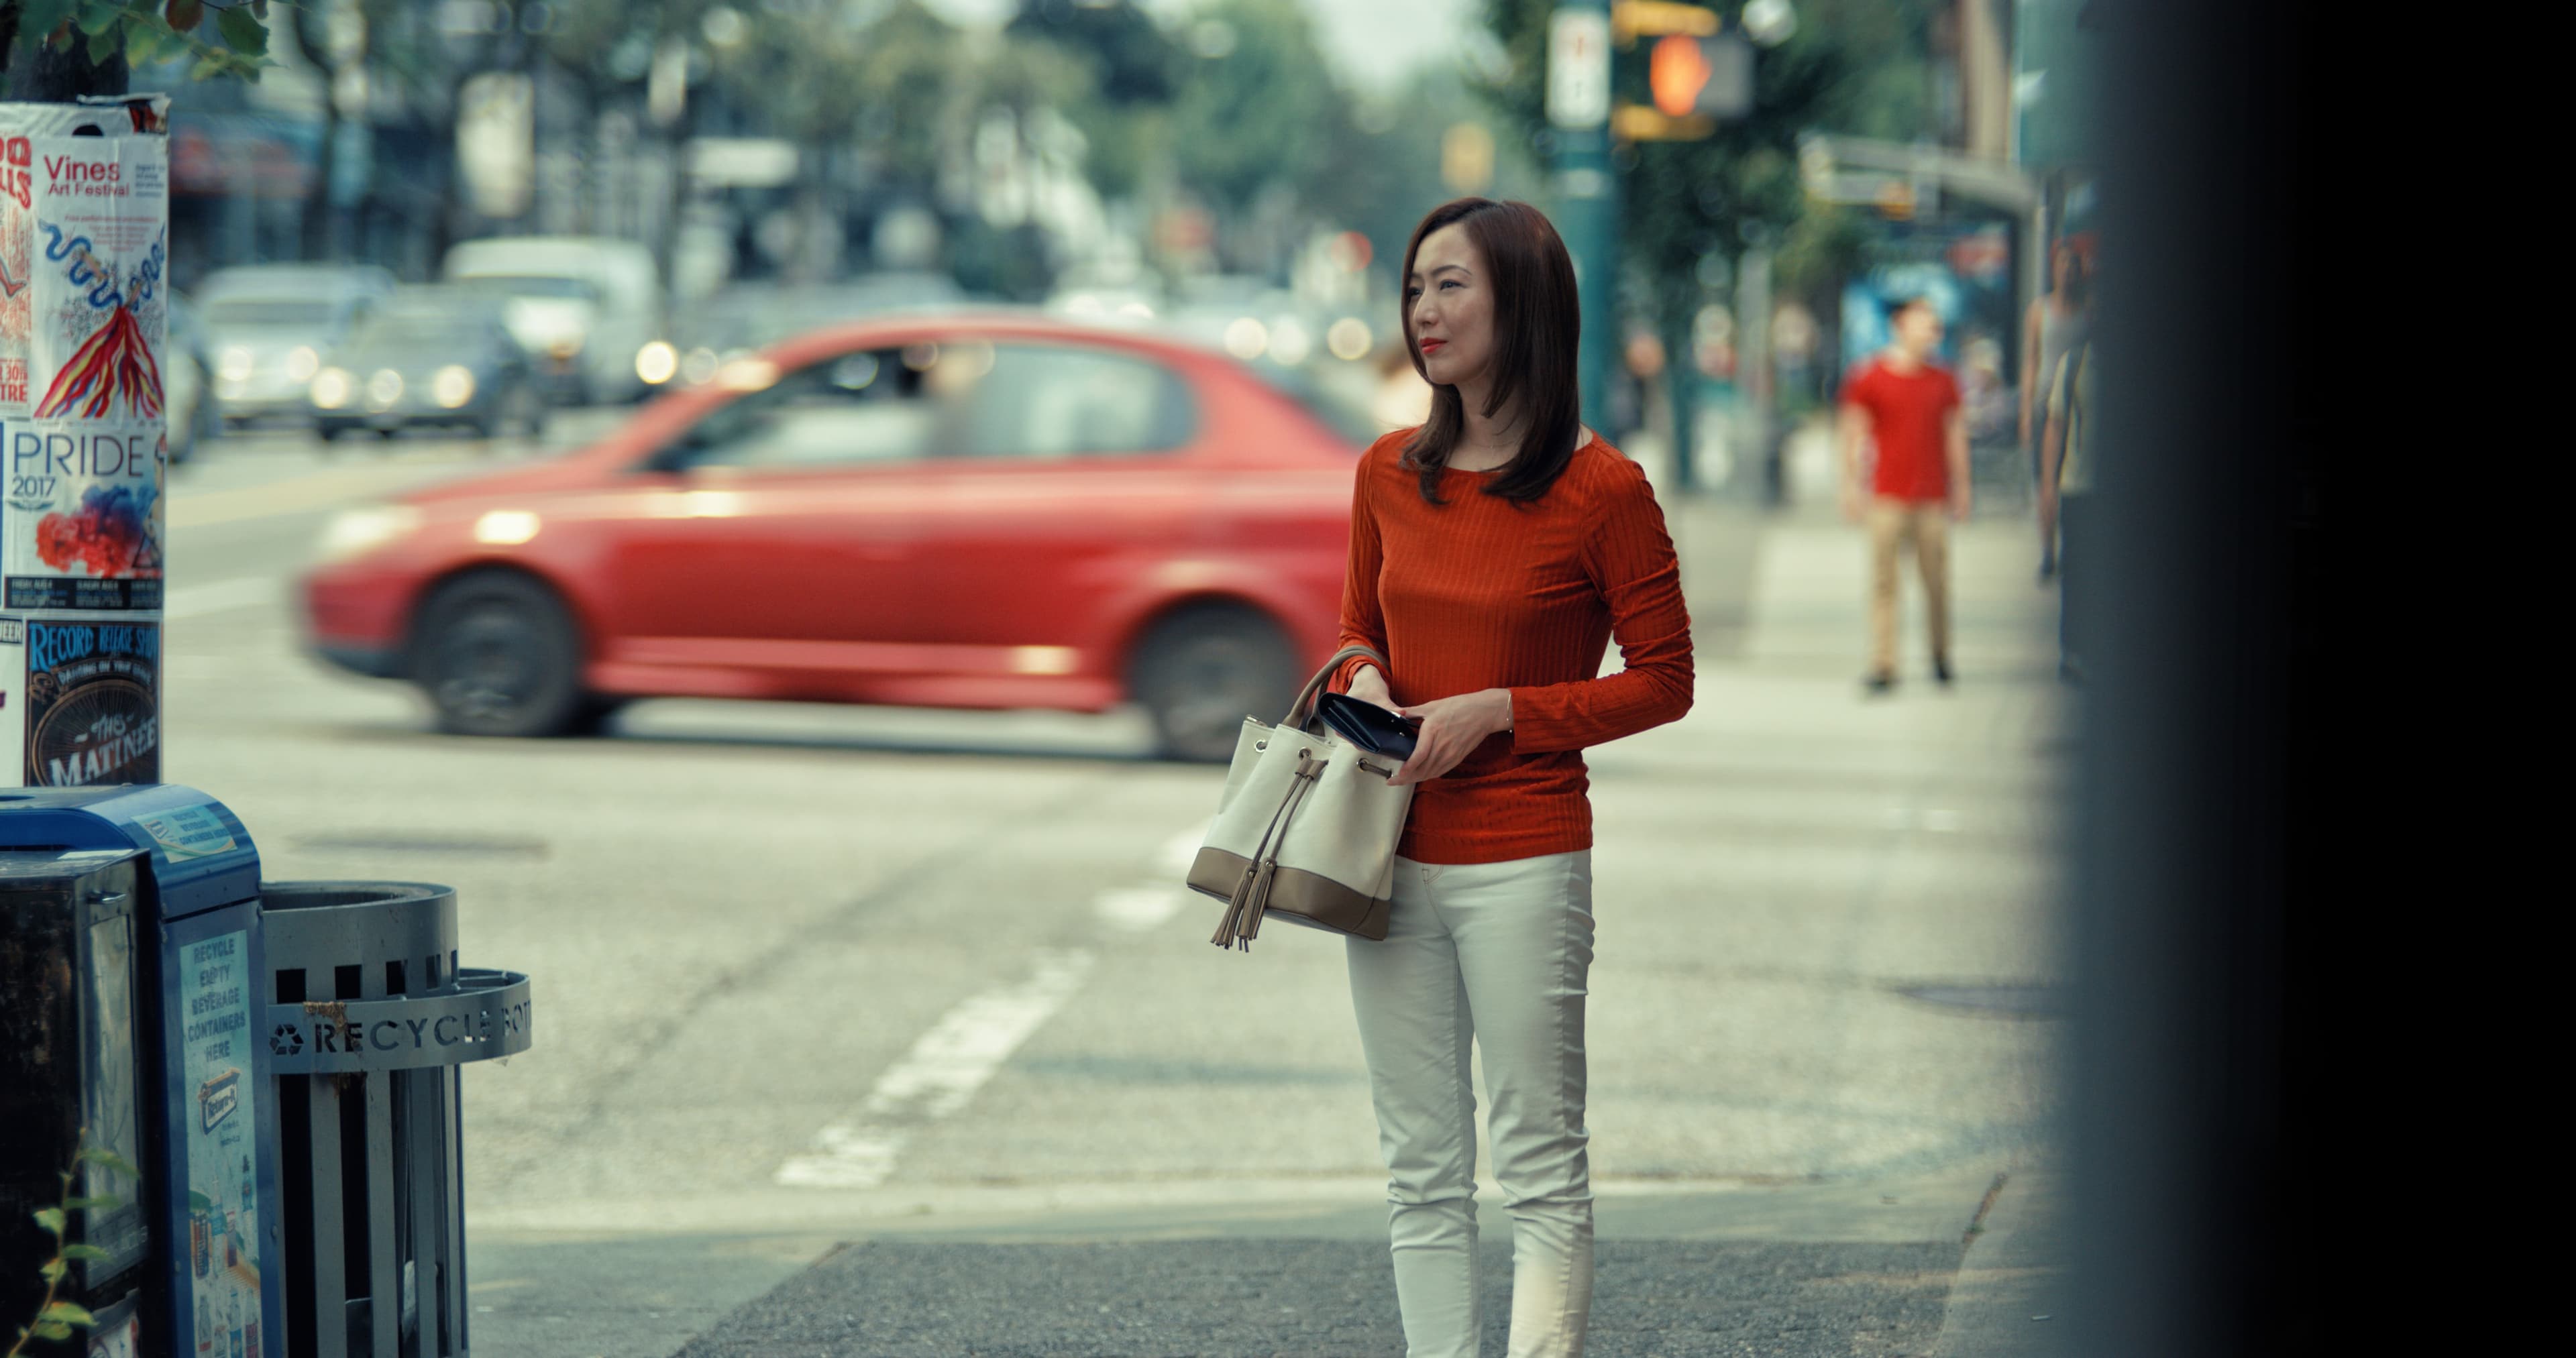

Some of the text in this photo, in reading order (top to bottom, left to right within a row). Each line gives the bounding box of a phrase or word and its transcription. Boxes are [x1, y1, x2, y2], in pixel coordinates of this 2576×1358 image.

[44, 154, 121, 182] Vines
[48, 182, 70, 196] Art
[74, 182, 130, 196] Festival
[14, 431, 144, 477] PRIDE
[12, 475, 56, 498] 2017
[29, 622, 94, 673] RECORD
[50, 716, 156, 787] MATINEE
[193, 938, 235, 964] RECYCLE
[199, 964, 231, 987] EMPTY
[192, 987, 240, 1015] BEVERAGE
[187, 1010, 246, 1042] CONTAINERS
[315, 1010, 492, 1053] RECYCLE
[205, 1040, 231, 1062] HERE
